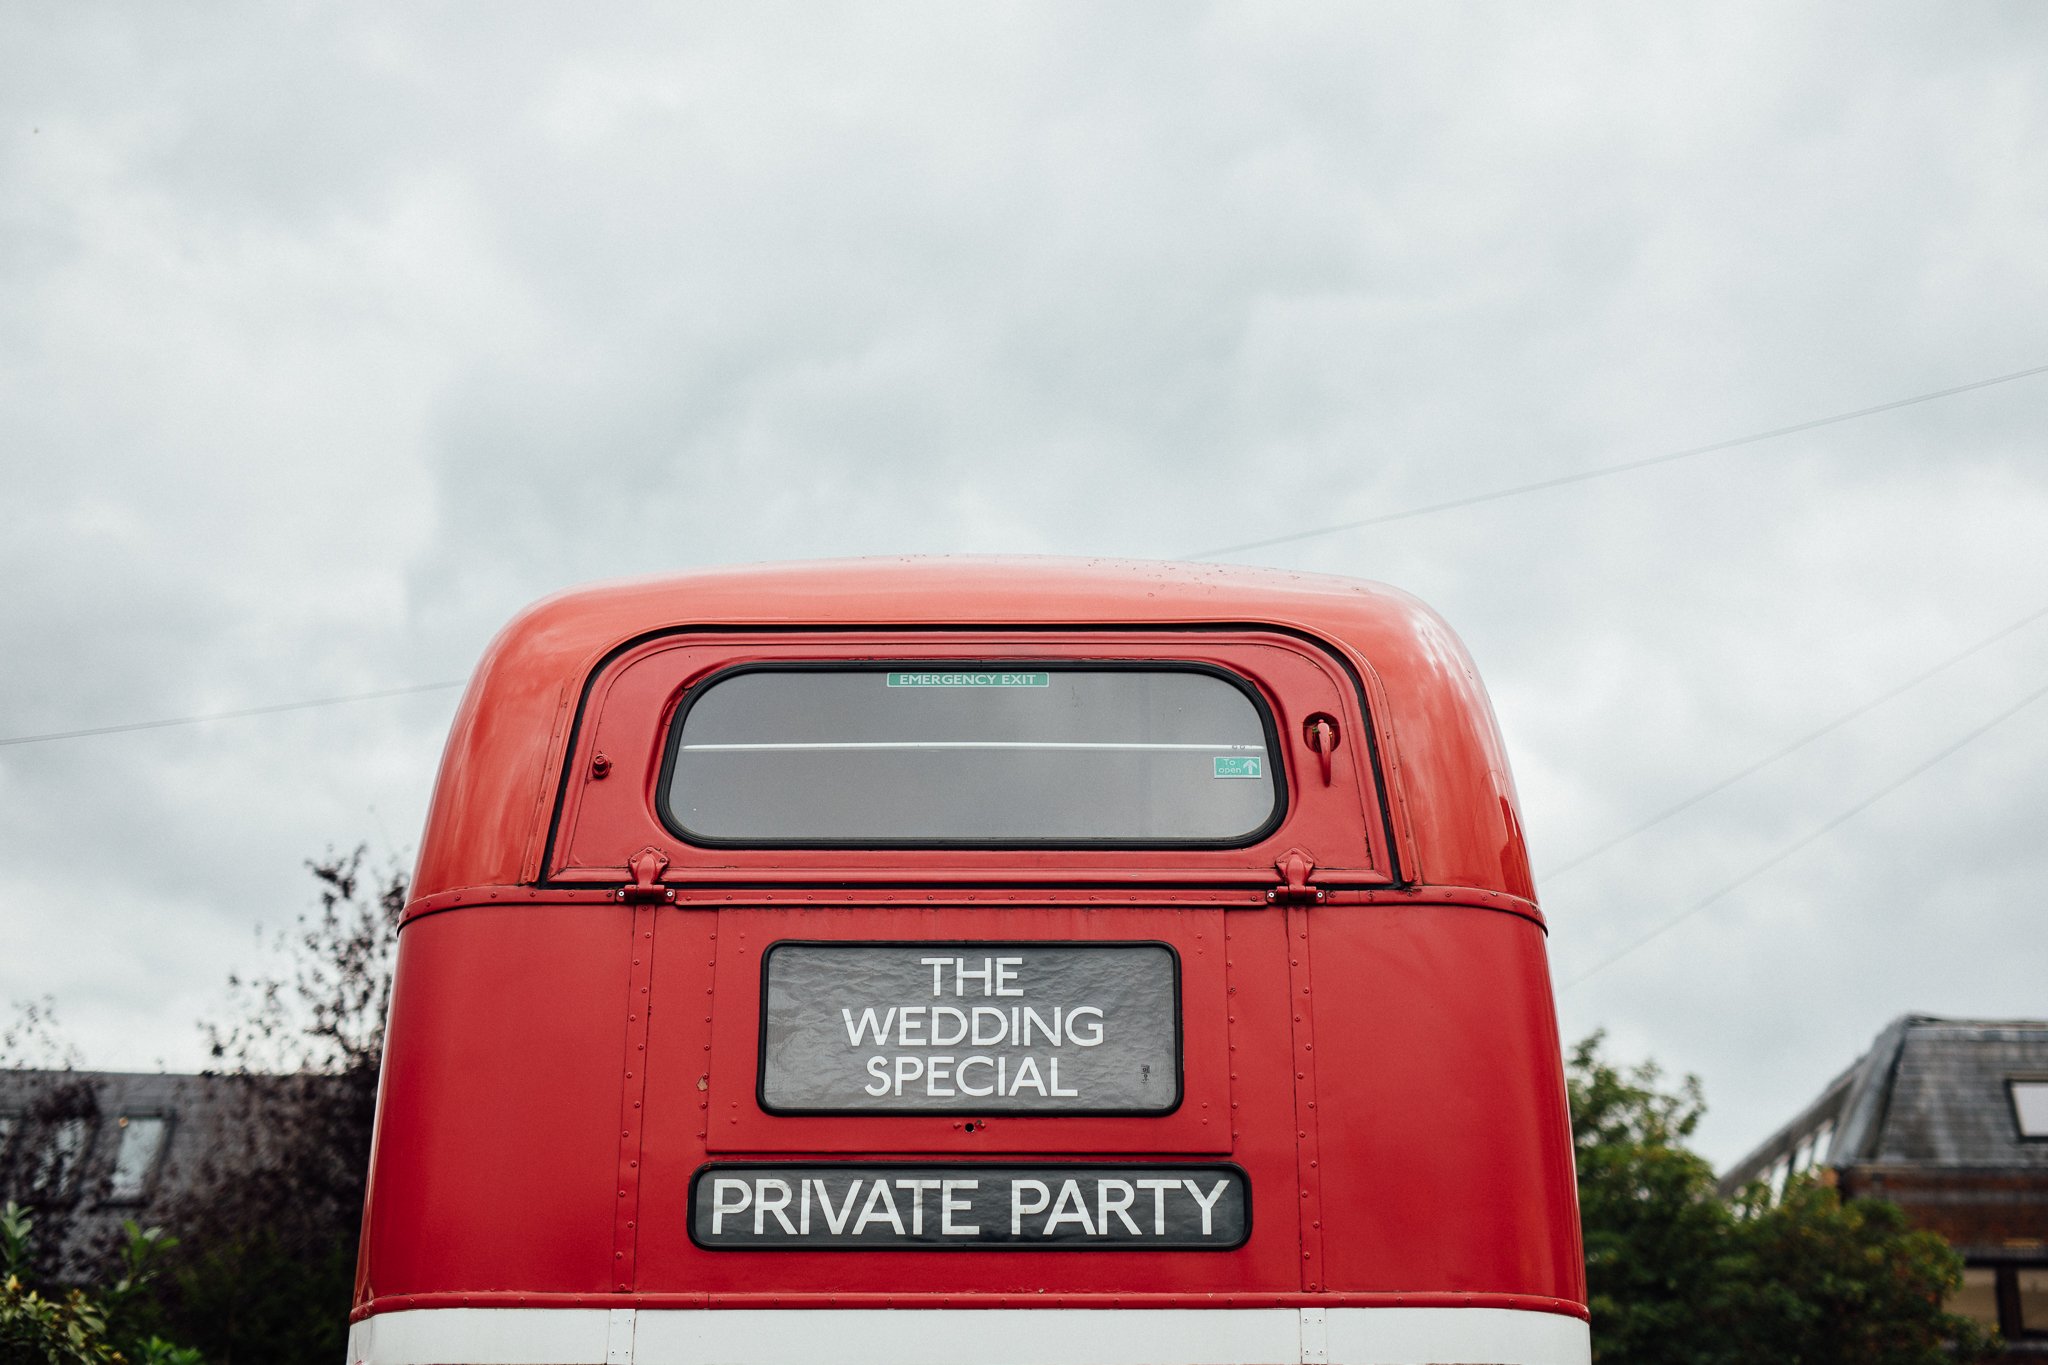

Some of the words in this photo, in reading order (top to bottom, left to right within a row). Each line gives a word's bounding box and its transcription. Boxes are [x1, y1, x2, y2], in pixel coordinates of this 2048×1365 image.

[900, 674, 997, 685] EMERGENCY
[1001, 674, 1037, 685] EXIT
[1218, 767, 1242, 775] open
[1223, 758, 1236, 766] To
[920, 957, 1024, 996] THE
[841, 1006, 1105, 1047] WEDDING
[864, 1055, 1078, 1097] SPECIAL
[712, 1178, 980, 1235] PRIVATE
[1011, 1179, 1231, 1235] PARTY
